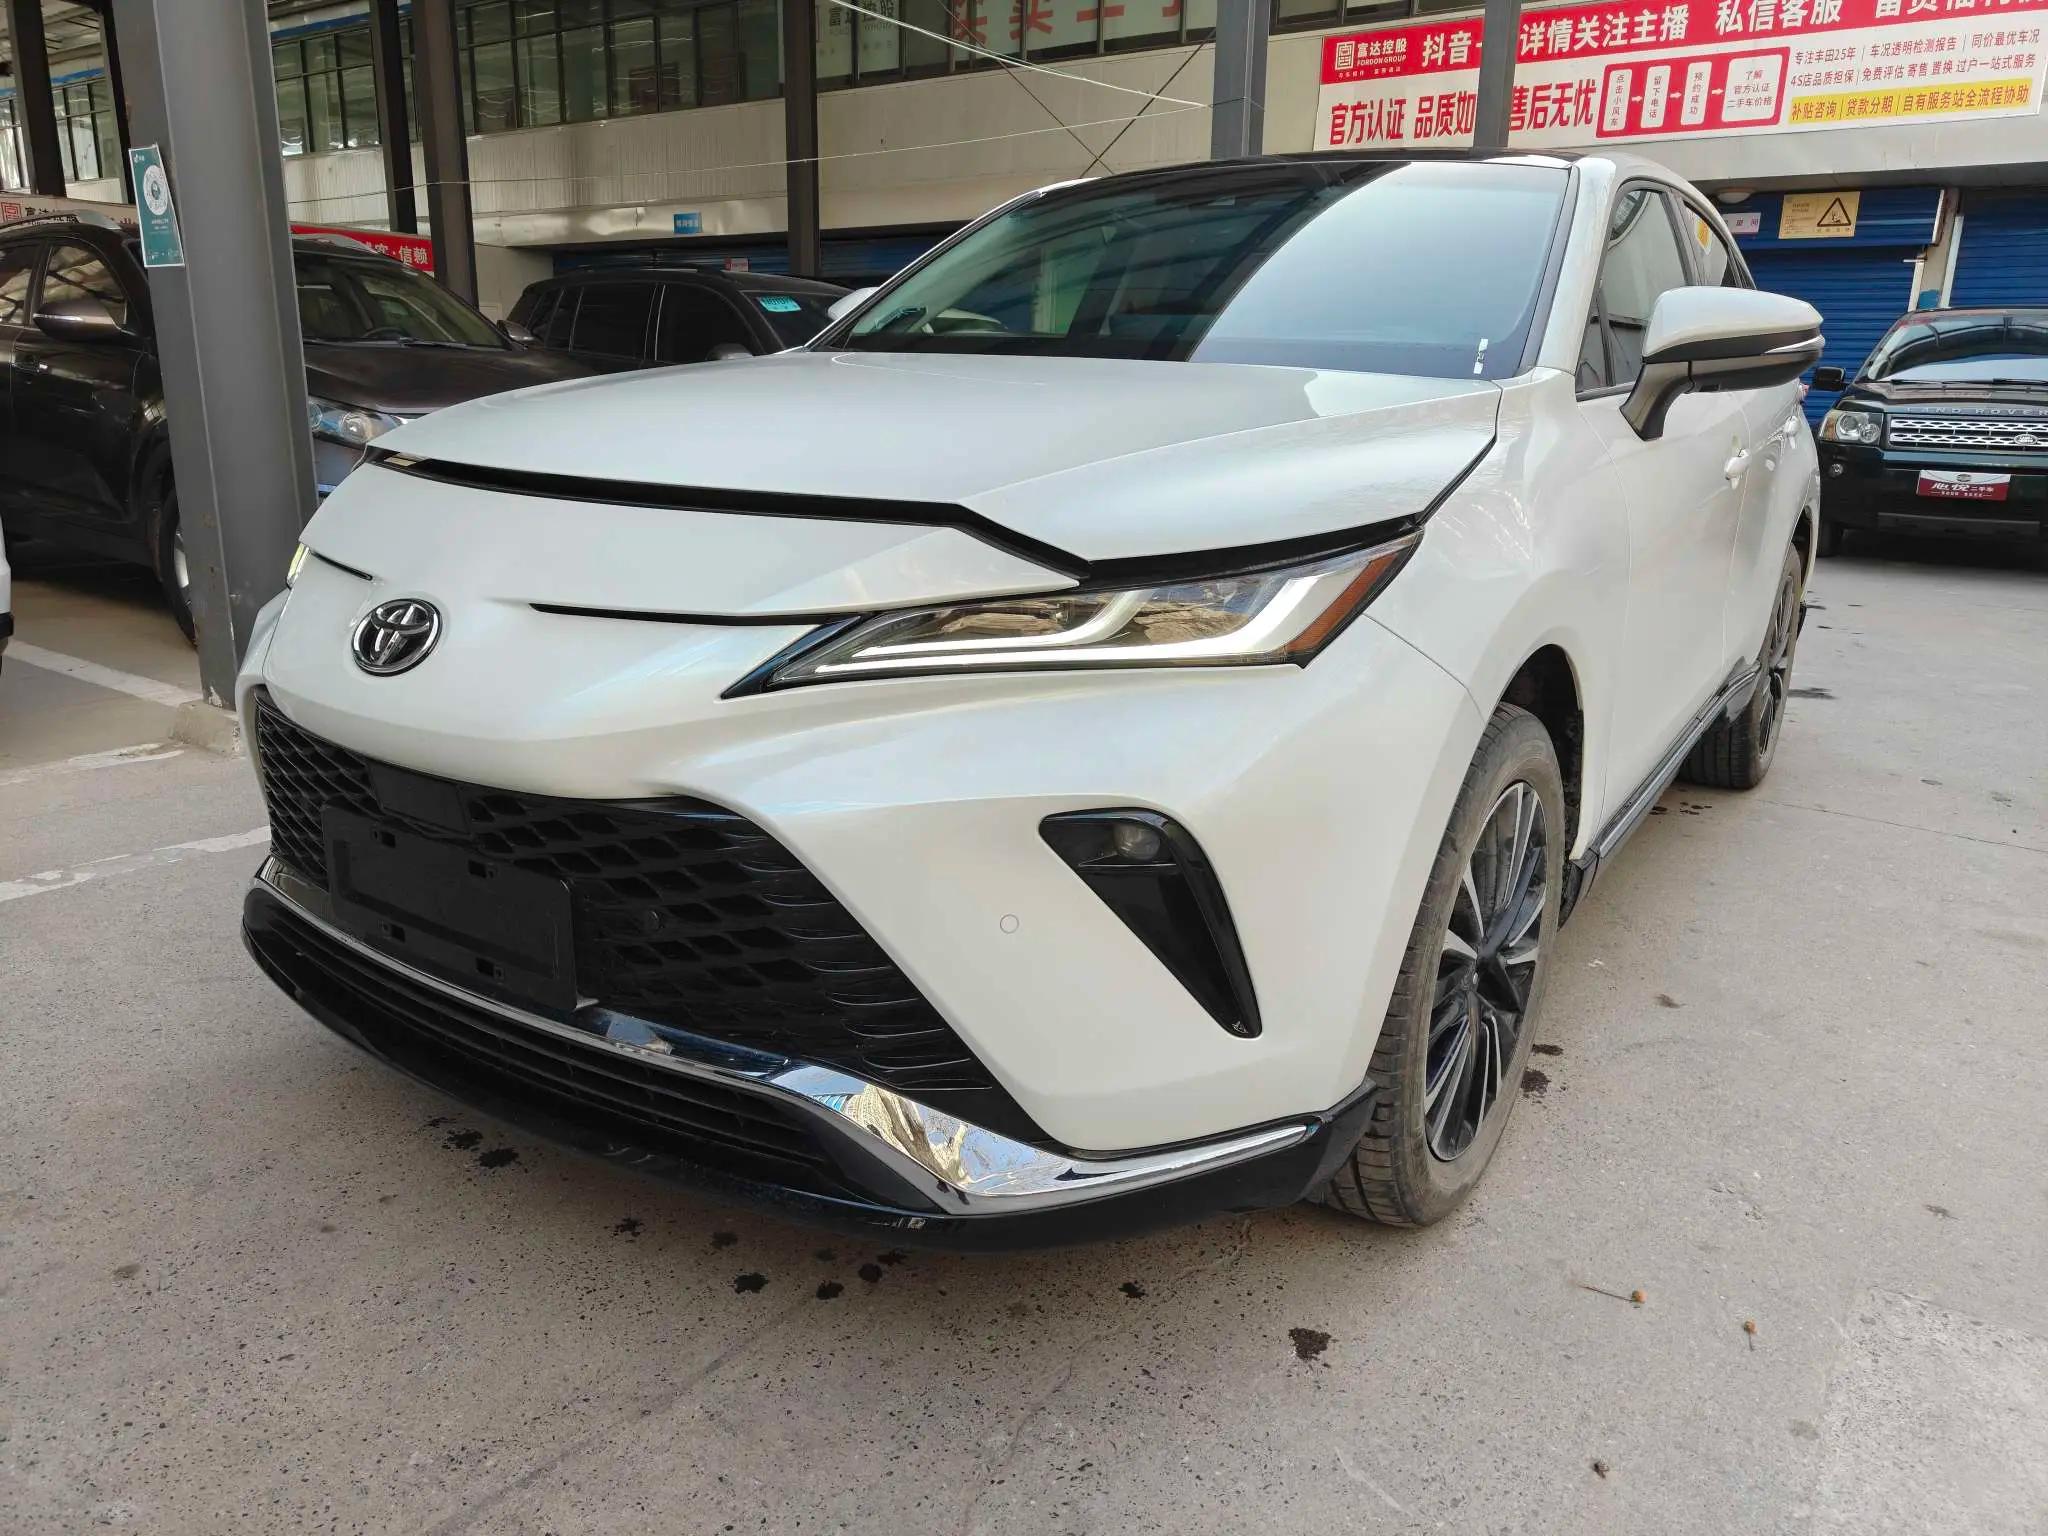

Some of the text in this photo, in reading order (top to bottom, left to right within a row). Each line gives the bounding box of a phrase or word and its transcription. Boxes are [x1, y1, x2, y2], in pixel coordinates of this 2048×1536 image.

[1358, 38, 1407, 57] 富达控股
[1421, 30, 1483, 67] 抖音
[1519, 4, 1689, 56] 详情关注主播
[1715, 0, 1843, 37] 私信客服
[1795, 28, 2040, 65] 专注丰田25年 车况透明检测报告 同价最优车况
[1357, 55, 1407, 67] FORDON GROUP
[1745, 69, 1763, 80] 了解
[1791, 54, 2036, 87] 4S店品质担保 免费评估 寄售 置换 过户一站式服务
[1611, 74, 1625, 127] 点击小风车
[1648, 75, 1663, 119] 留下电话
[1688, 71, 1705, 115] 预约成功
[1727, 96, 1772, 109] 二手车价格
[1733, 83, 1770, 95] 官方认证
[1792, 84, 2030, 121] 补贴咨询 贷款分期 自有服务站全流程协助
[1330, 98, 1407, 145] 官方认证
[1509, 79, 1597, 132] 售后无忧
